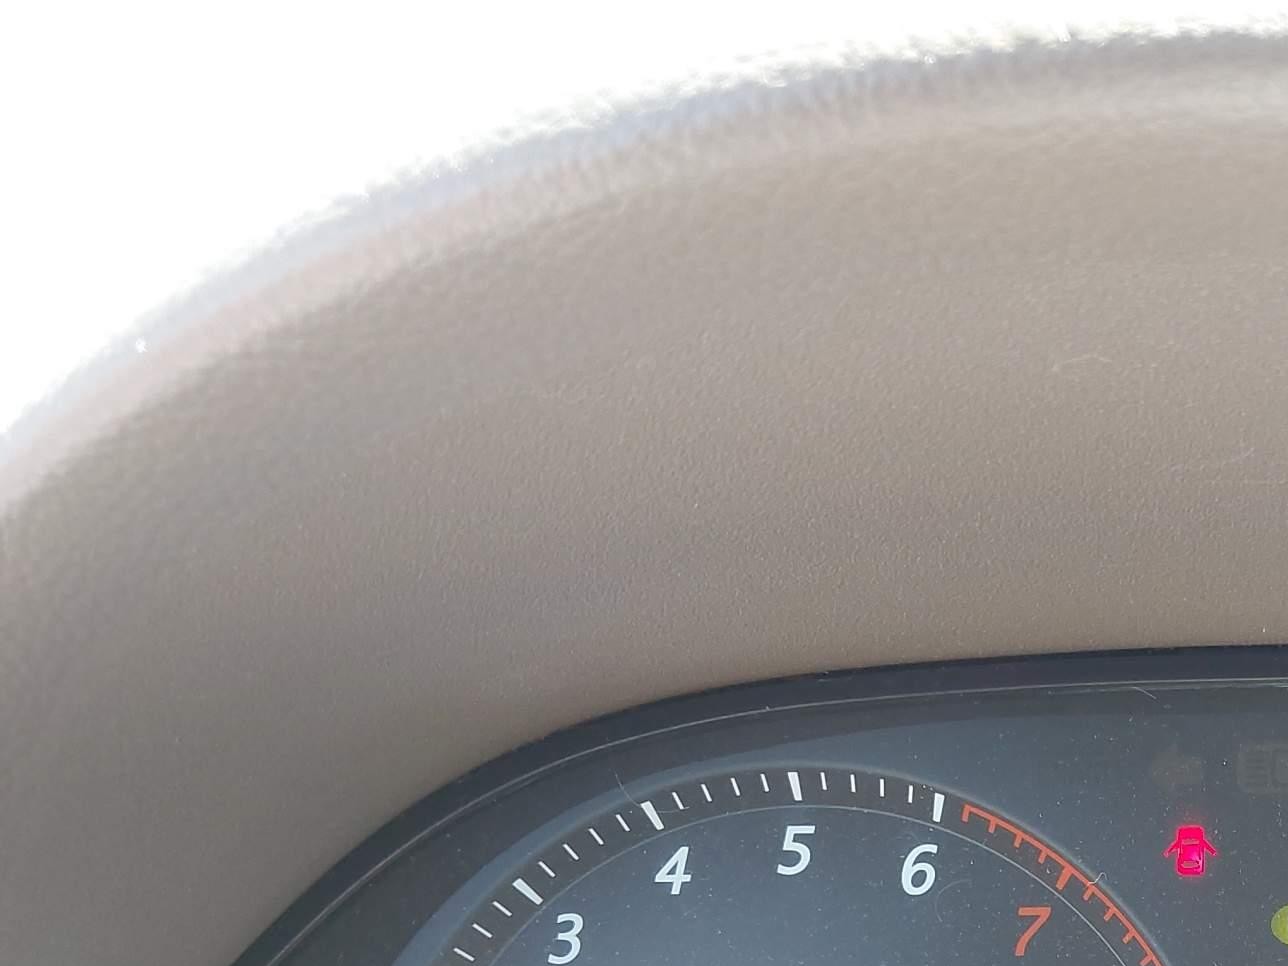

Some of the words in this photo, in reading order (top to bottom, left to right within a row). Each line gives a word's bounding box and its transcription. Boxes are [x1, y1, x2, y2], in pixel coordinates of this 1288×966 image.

[654, 847, 691, 894] 4
[777, 826, 815, 875] 5
[900, 844, 937, 895] 6
[548, 913, 583, 964] 3
[1015, 907, 1051, 956] 7
